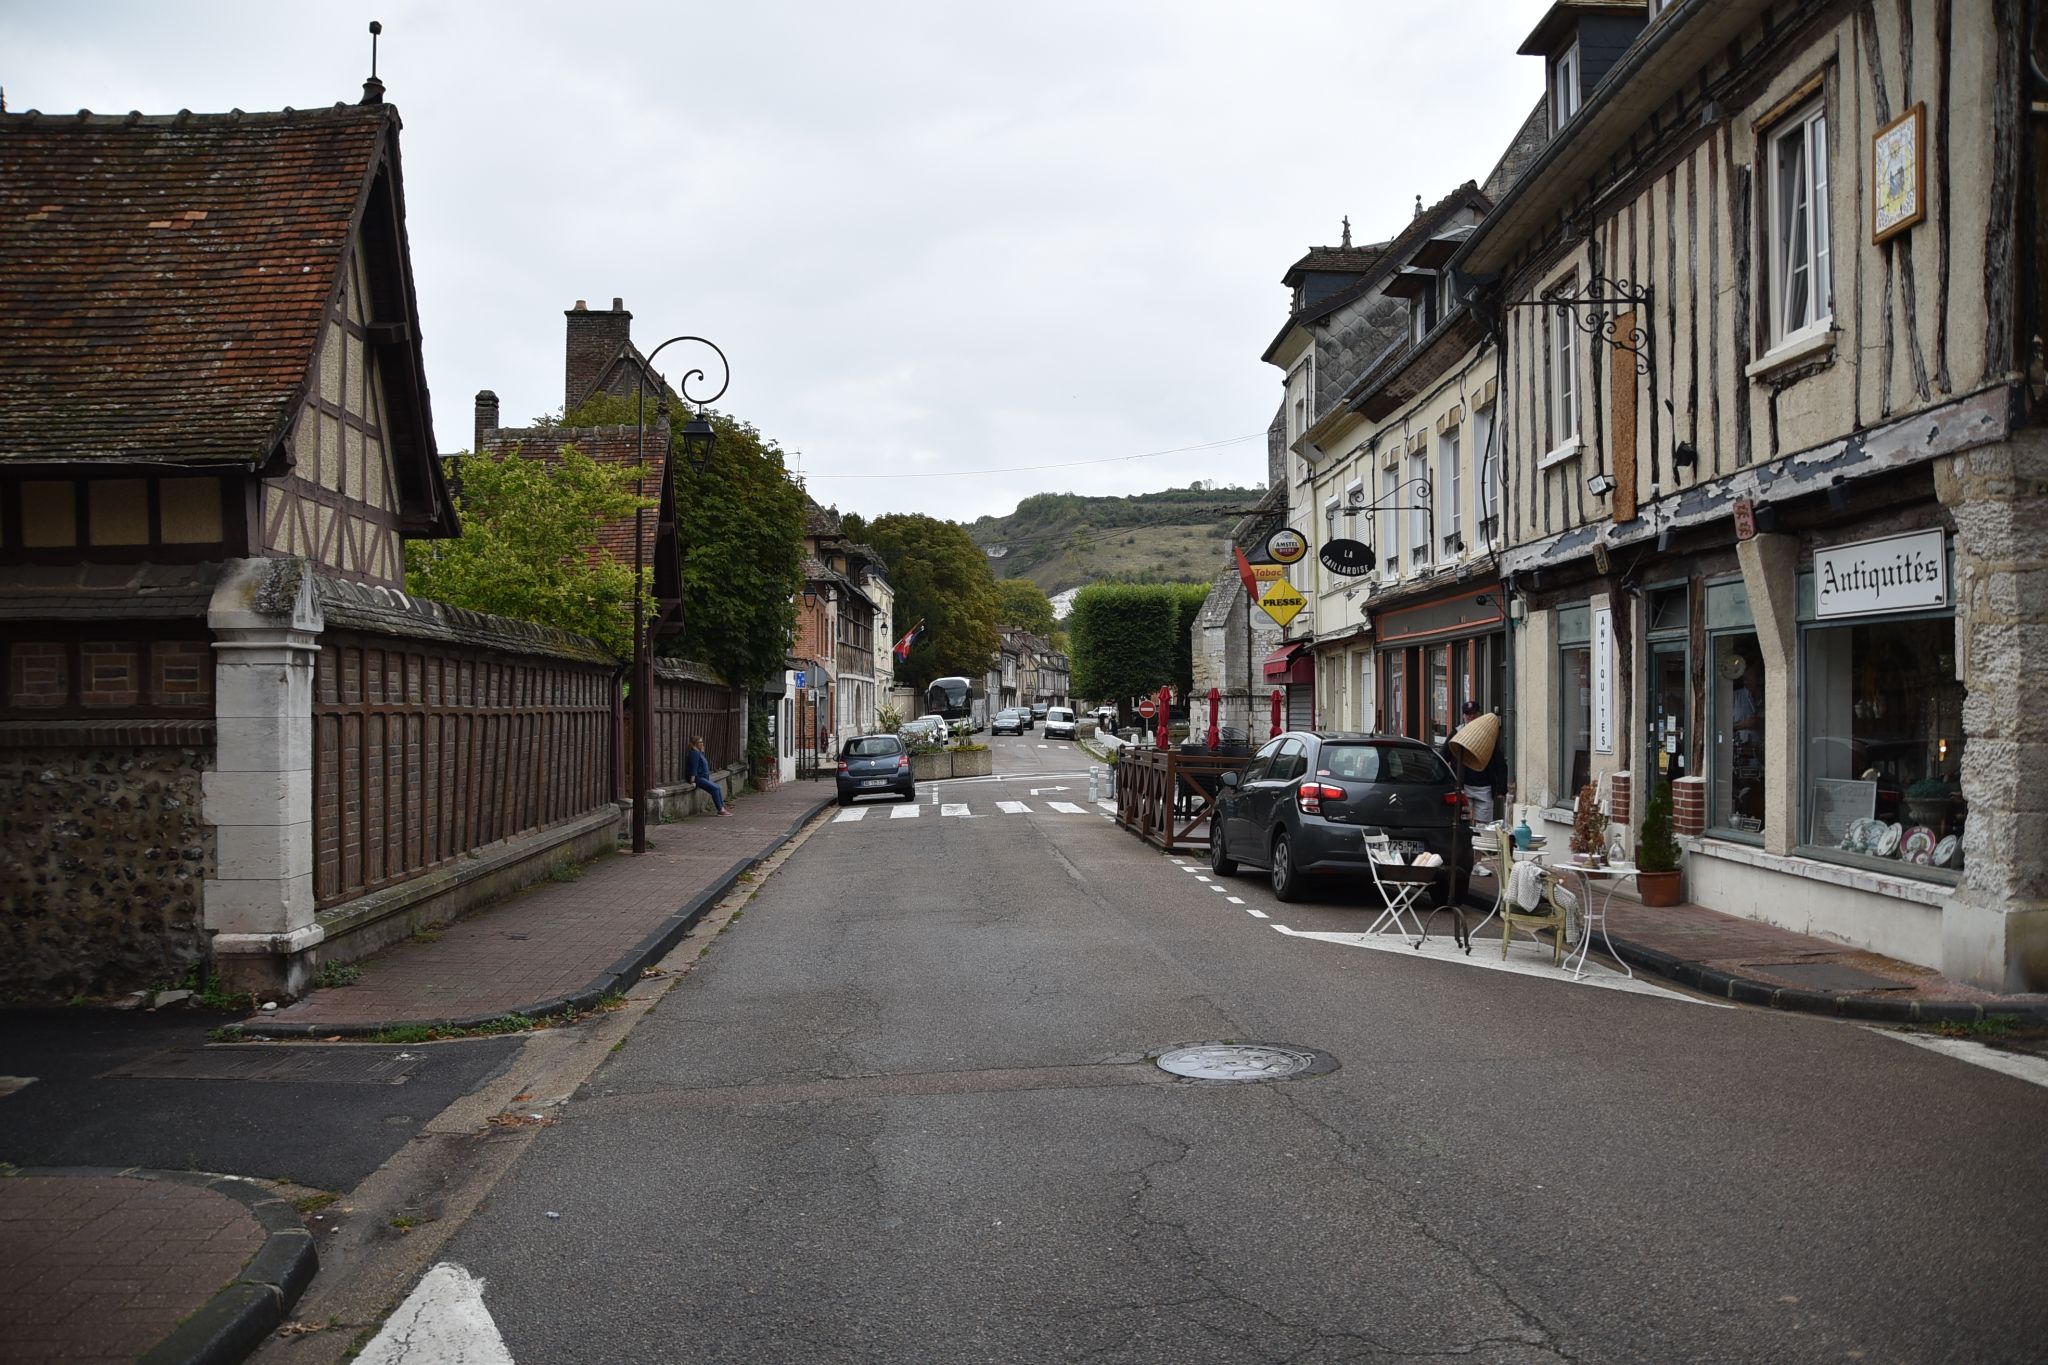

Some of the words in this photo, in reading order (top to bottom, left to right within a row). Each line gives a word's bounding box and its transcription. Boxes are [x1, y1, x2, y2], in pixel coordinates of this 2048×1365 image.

[1344, 550, 1353, 559] LA
[1322, 555, 1369, 575] GAILLARDISE
[1255, 568, 1282, 577] Tabac
[1820, 552, 1938, 605] Antiquités
[1263, 598, 1302, 607] PRESSE
